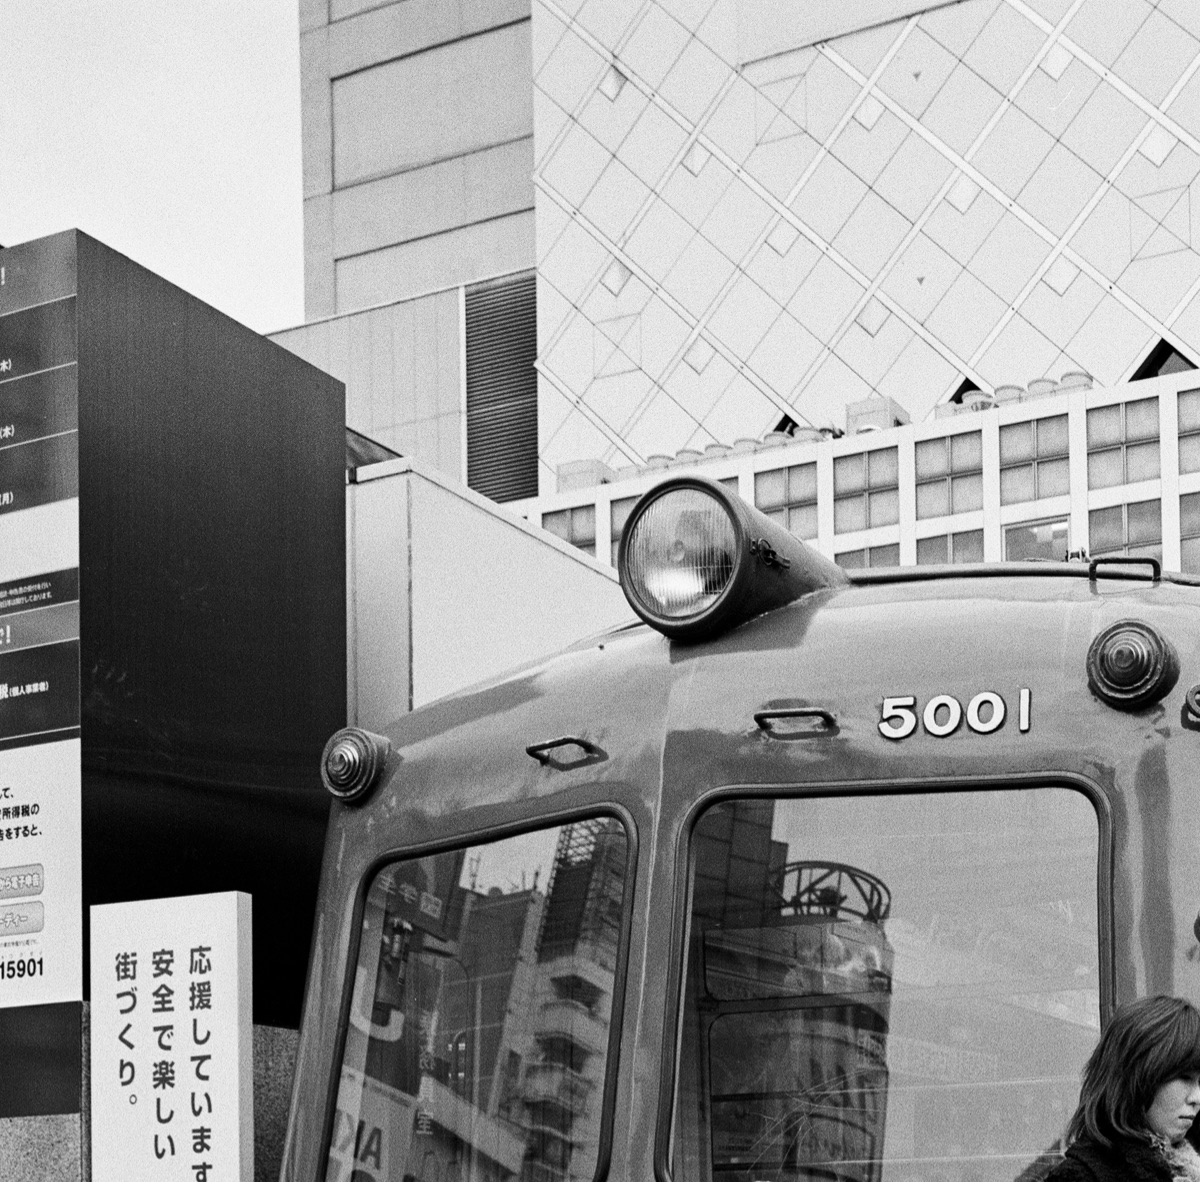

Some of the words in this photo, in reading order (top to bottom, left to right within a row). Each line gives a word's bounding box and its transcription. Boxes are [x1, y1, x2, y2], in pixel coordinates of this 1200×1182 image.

[877, 687, 1032, 739] 5001
[0, 803, 40, 820] 所得税の
[0, 956, 43, 980] 15901
[115, 952, 138, 1105] 街づくり。
[152, 949, 176, 1160] 安全で楽しい
